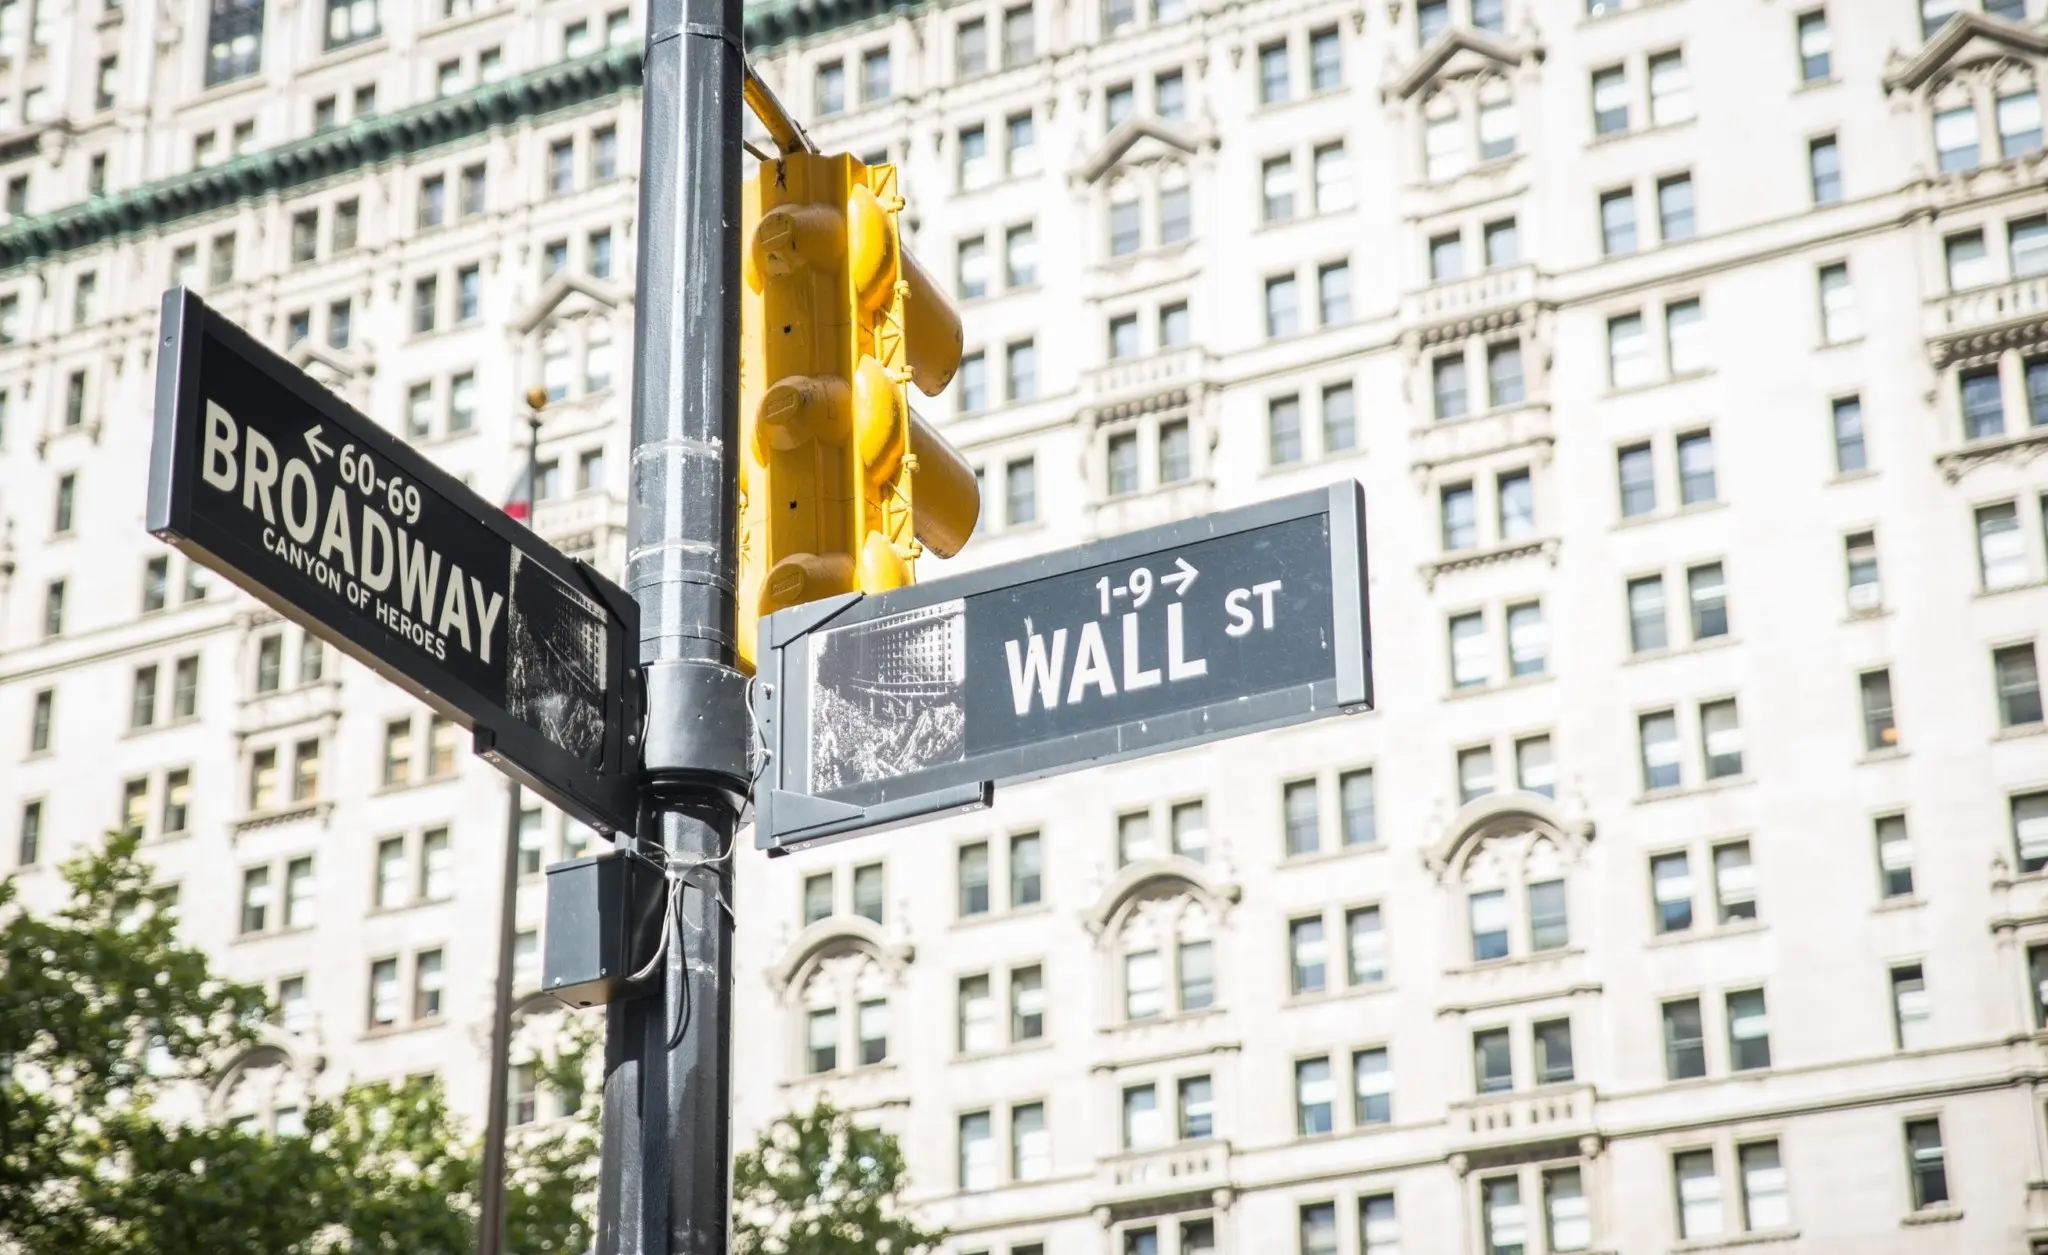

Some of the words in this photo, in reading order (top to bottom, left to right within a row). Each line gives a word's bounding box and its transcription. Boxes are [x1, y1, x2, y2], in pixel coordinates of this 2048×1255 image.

[202, 398, 504, 665] BROADWAY
[339, 443, 421, 525] 60-69
[262, 527, 341, 595] CANYON
[346, 580, 371, 610] OF
[375, 598, 446, 661] HEROES
[1004, 601, 1209, 717] WALL
[1224, 579, 1283, 638] ST
[1096, 567, 1154, 617] 1-9
